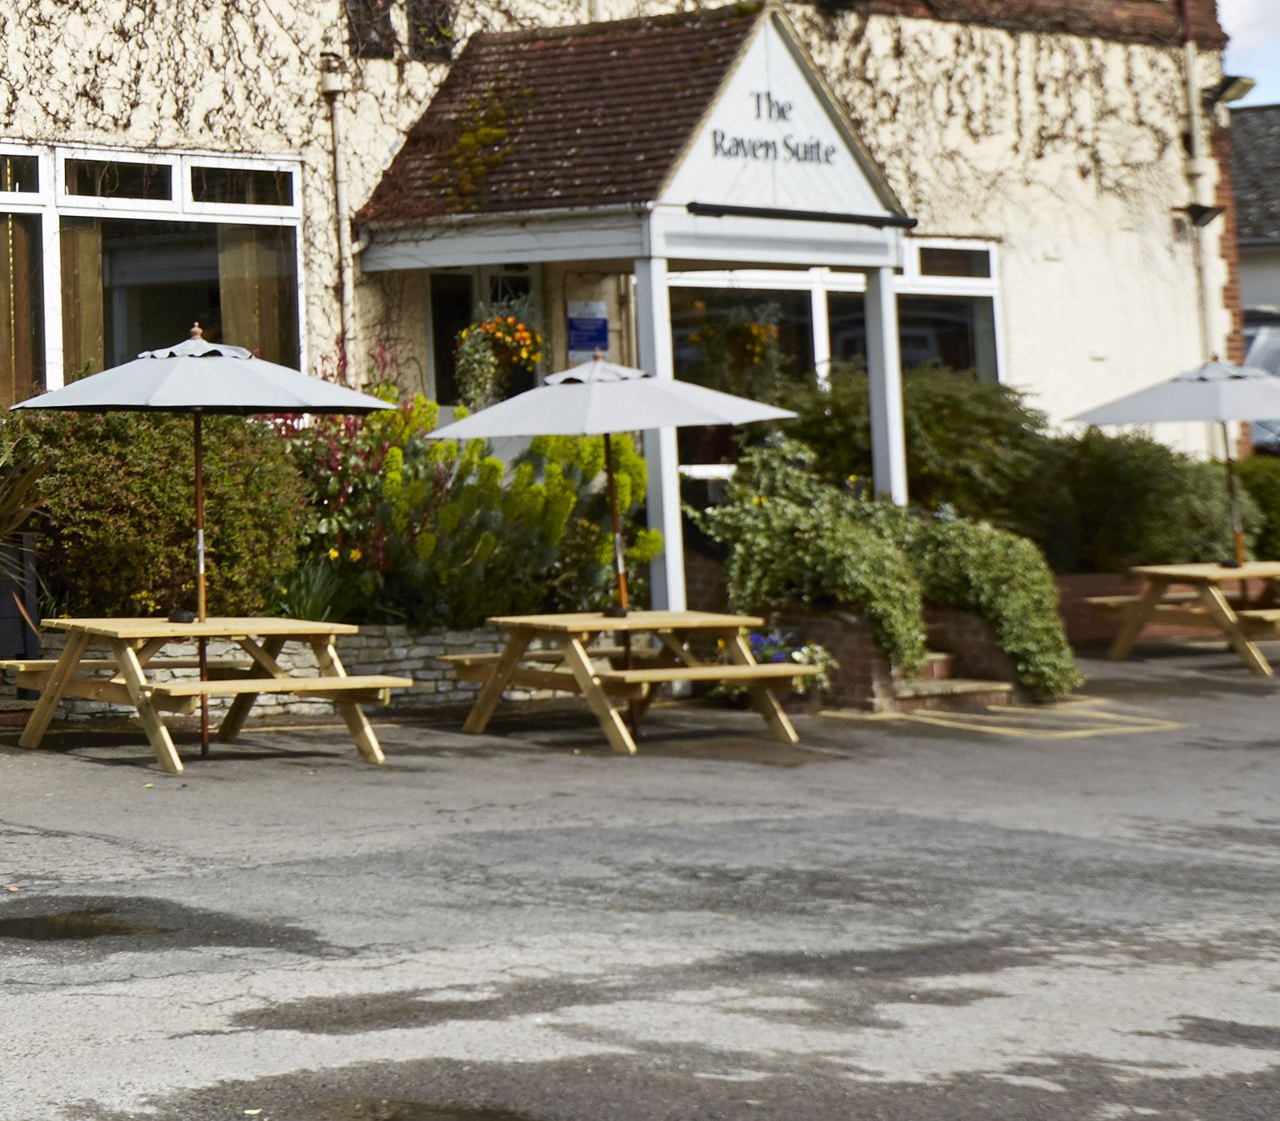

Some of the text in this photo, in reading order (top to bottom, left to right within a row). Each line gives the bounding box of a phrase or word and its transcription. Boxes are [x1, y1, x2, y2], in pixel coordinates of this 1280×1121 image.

[750, 91, 792, 122] The
[713, 130, 836, 166] Raven Suite
